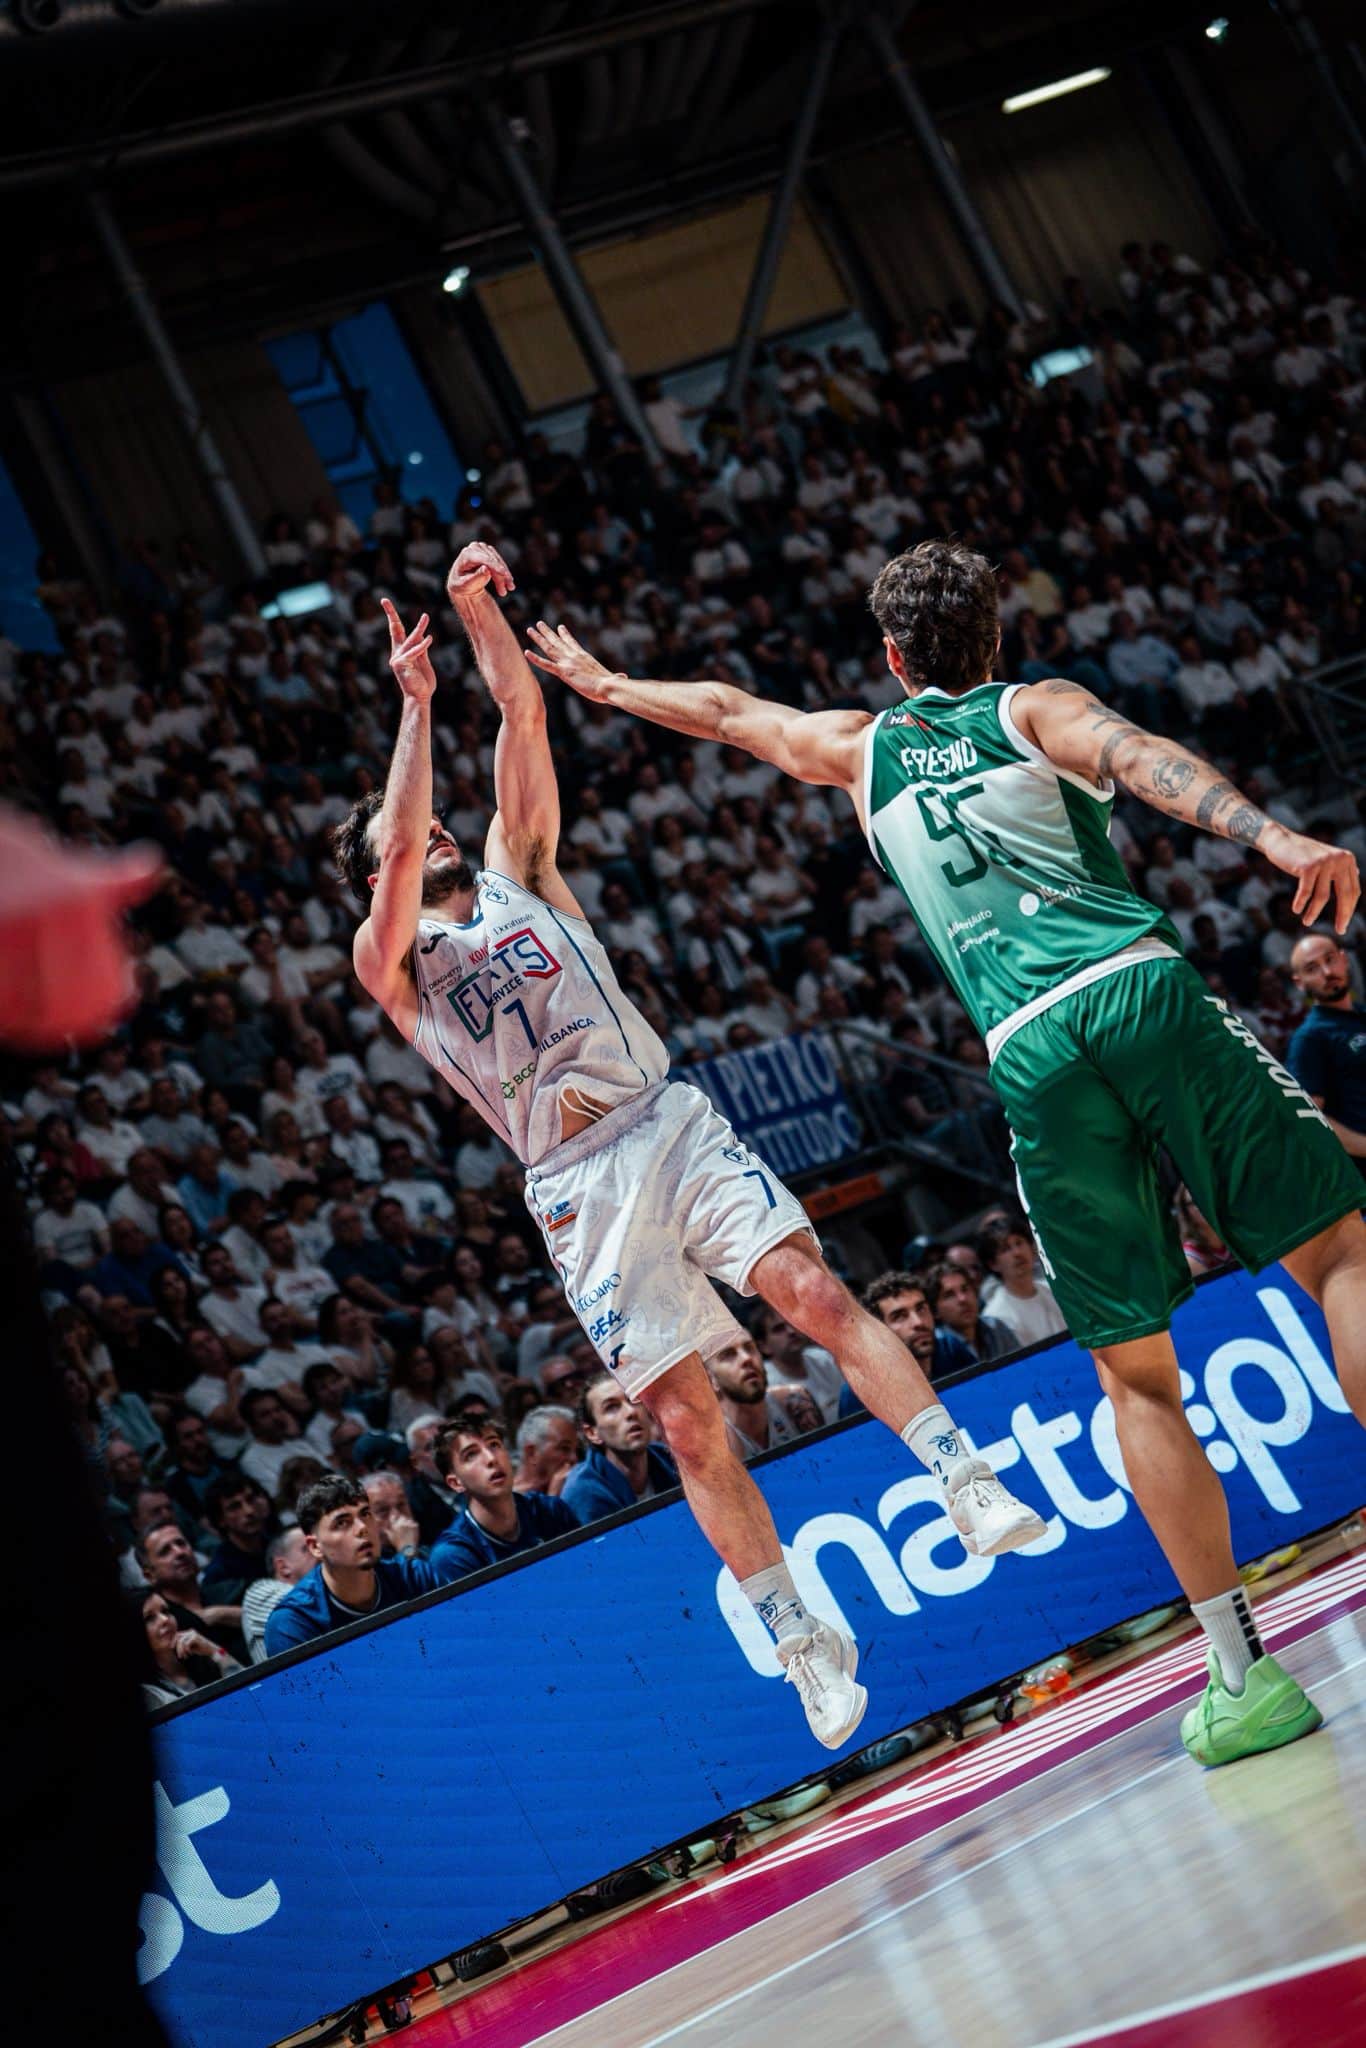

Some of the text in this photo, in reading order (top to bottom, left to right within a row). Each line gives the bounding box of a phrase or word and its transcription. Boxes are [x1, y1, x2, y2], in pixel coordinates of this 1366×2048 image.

[502, 997, 538, 1050] 7
[512, 1061, 537, 1085] BCC
[741, 1103, 862, 1177] TITUDO
[742, 1169, 777, 1209] 7
